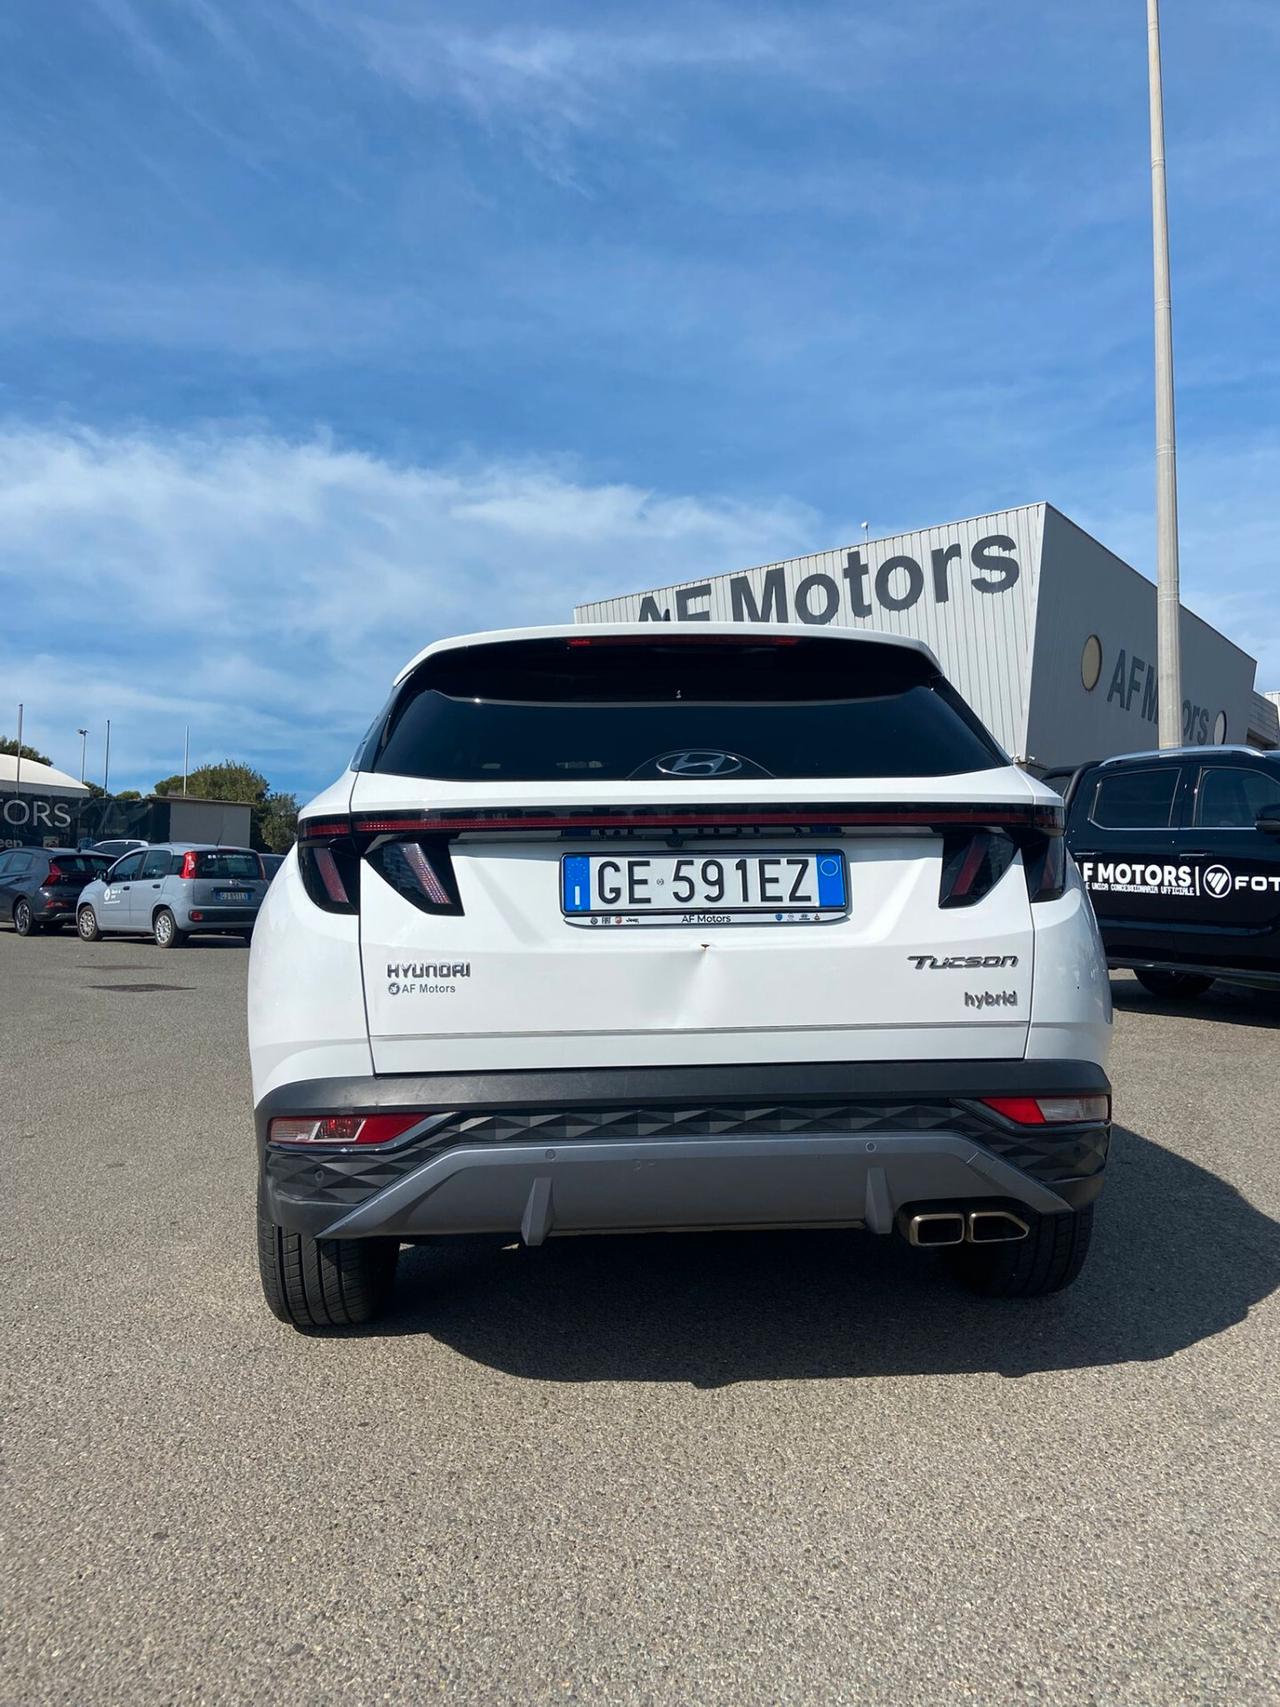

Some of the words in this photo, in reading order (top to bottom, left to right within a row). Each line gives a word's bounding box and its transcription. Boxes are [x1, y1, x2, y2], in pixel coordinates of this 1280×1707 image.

[730, 535, 1020, 624] Motors
[1141, 664, 1210, 745] Mors
[0, 799, 71, 828] ORS
[598, 860, 652, 904] GE
[672, 858, 812, 903] 591EZ
[1075, 862, 1094, 881] F
[1097, 863, 1192, 887] MOTORS
[1235, 876, 1280, 891] FOT
[681, 914, 695, 923] AF
[697, 914, 732, 923] Motors
[387, 962, 471, 979] HYUNDAI
[401, 983, 416, 994] AF
[419, 983, 456, 994] Motors
[964, 990, 1018, 1010] hybrid
